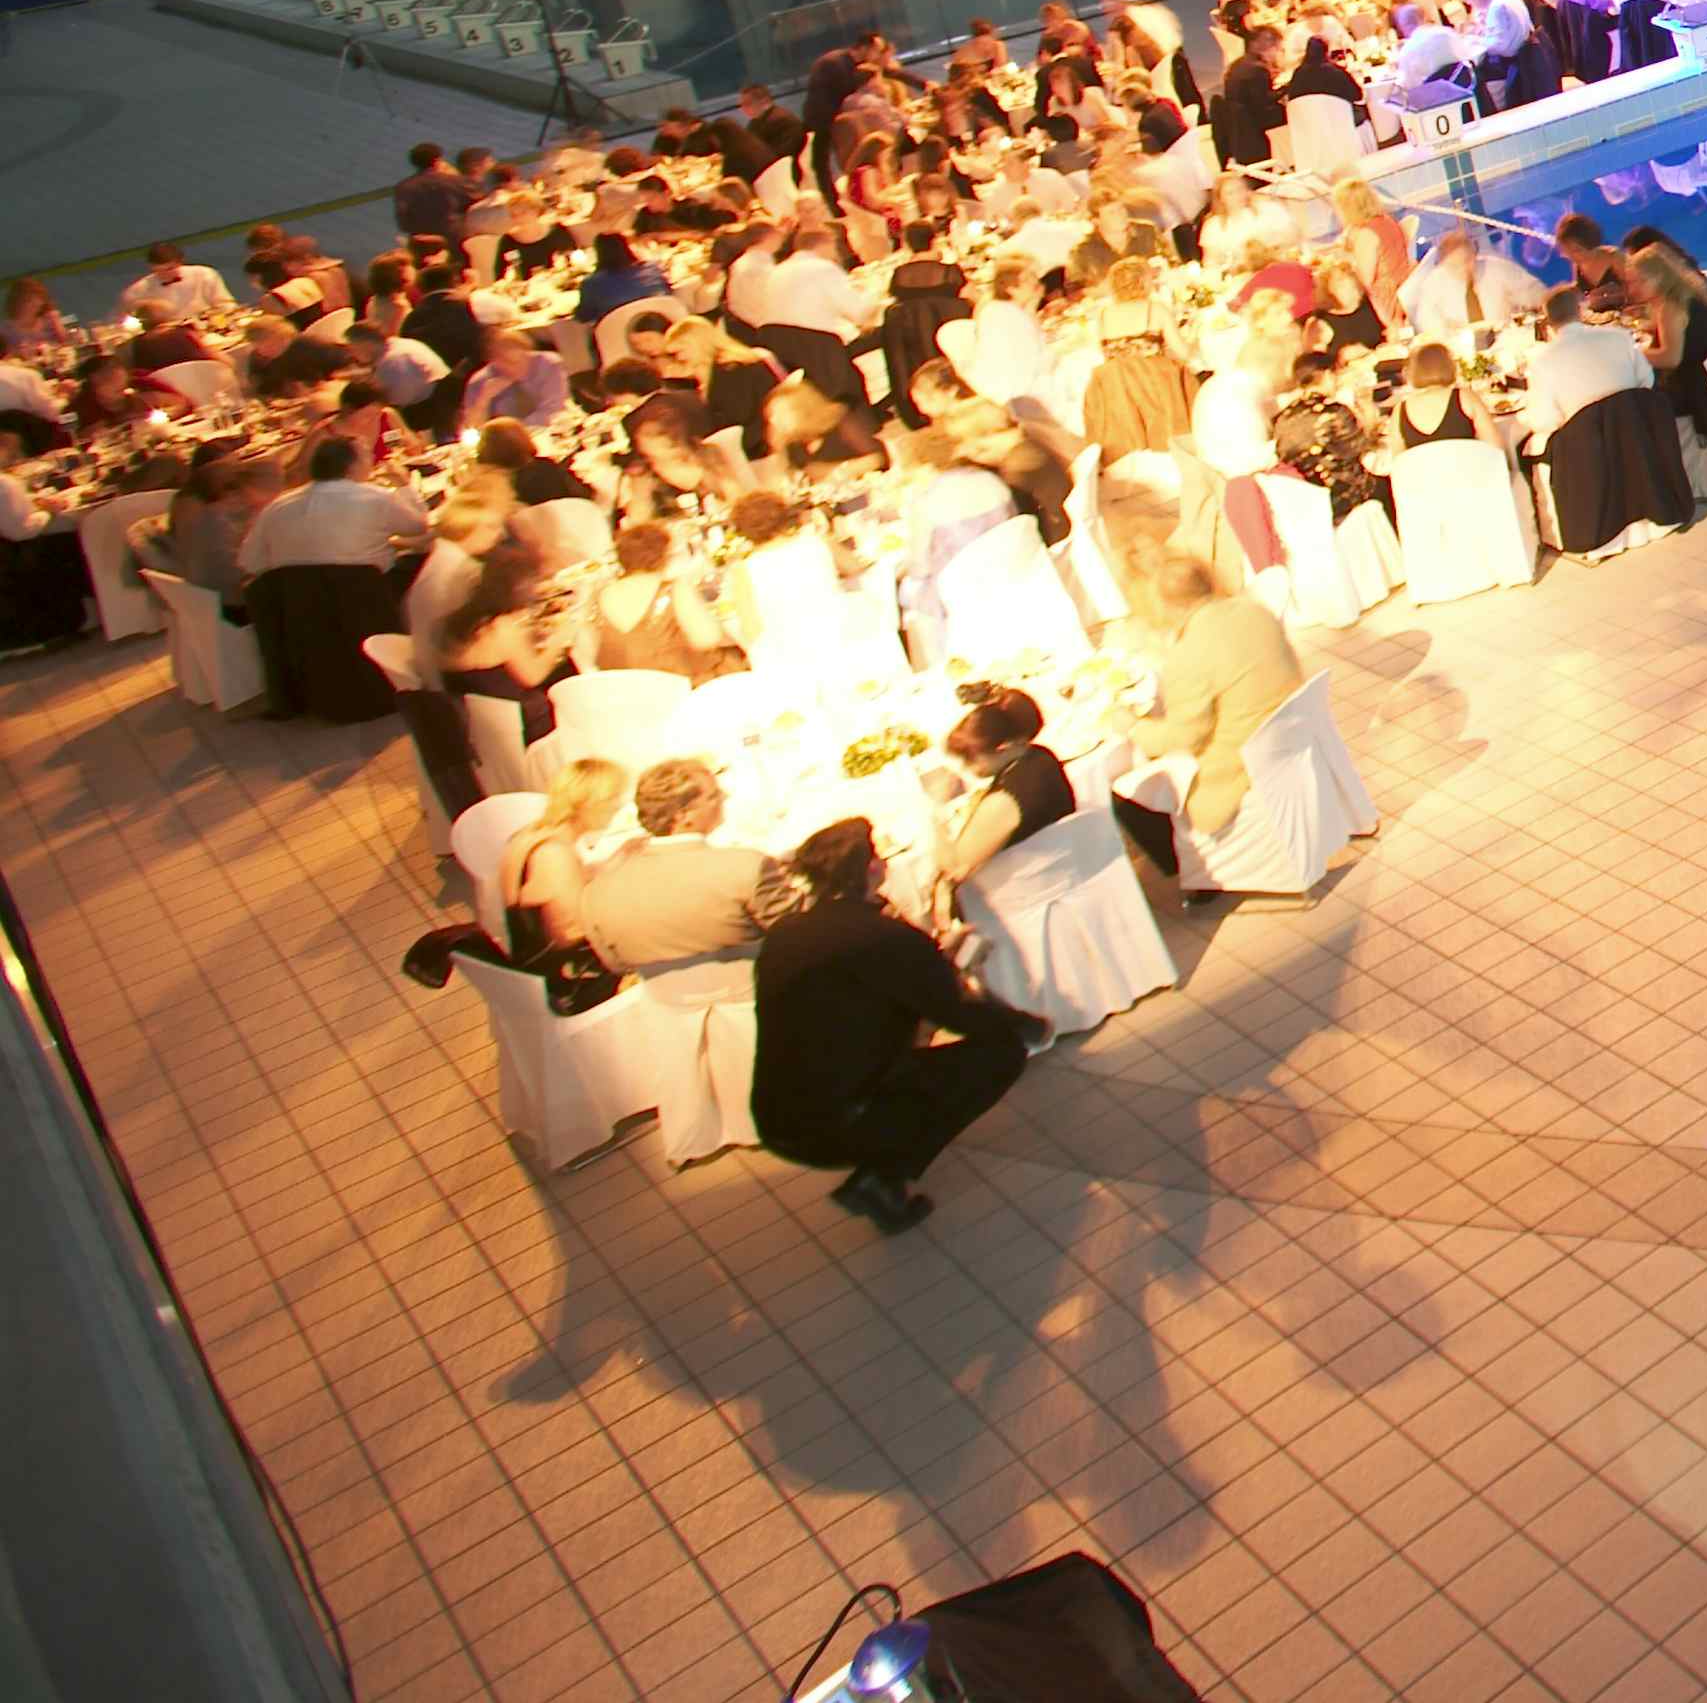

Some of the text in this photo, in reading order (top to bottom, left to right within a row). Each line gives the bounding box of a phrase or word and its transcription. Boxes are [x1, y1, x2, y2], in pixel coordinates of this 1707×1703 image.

[387, 13, 400, 26] 6
[424, 20, 438, 34] 5
[466, 29, 480, 41] 4
[508, 38, 523, 52] 3
[559, 48, 574, 63] 2
[613, 60, 625, 75] 1
[1436, 114, 1450, 136] 0
